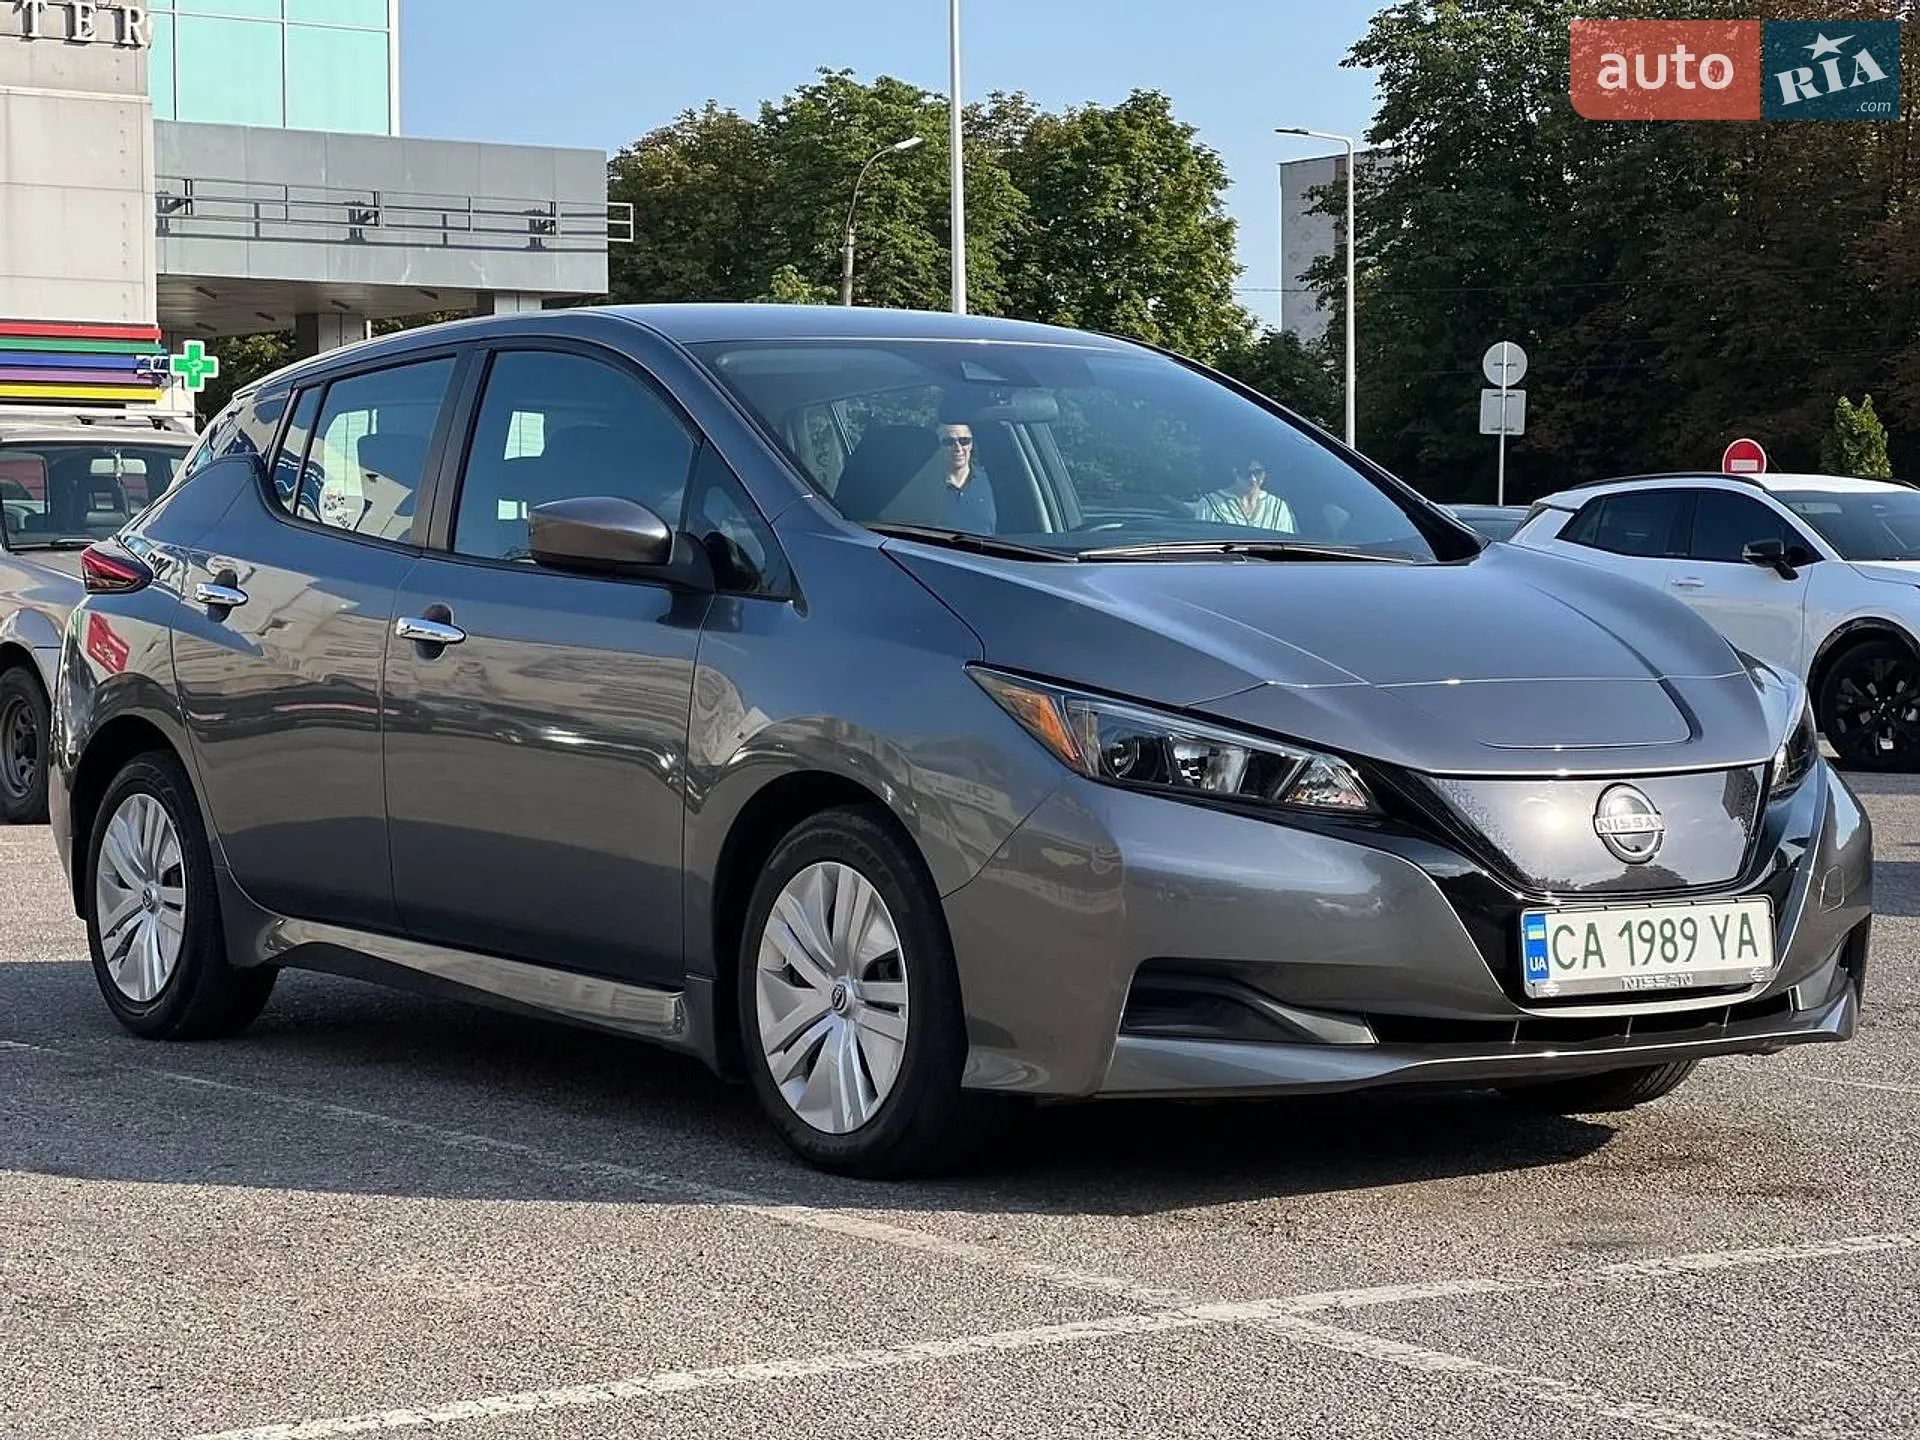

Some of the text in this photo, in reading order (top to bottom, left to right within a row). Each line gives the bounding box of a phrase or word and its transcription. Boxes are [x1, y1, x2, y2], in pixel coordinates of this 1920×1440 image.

[1596, 814, 1661, 831] NISSAN
[1552, 912, 1758, 970] CA 1989 YA
[1529, 956, 1548, 972] UA
[1620, 973, 1694, 991] NISSAN
